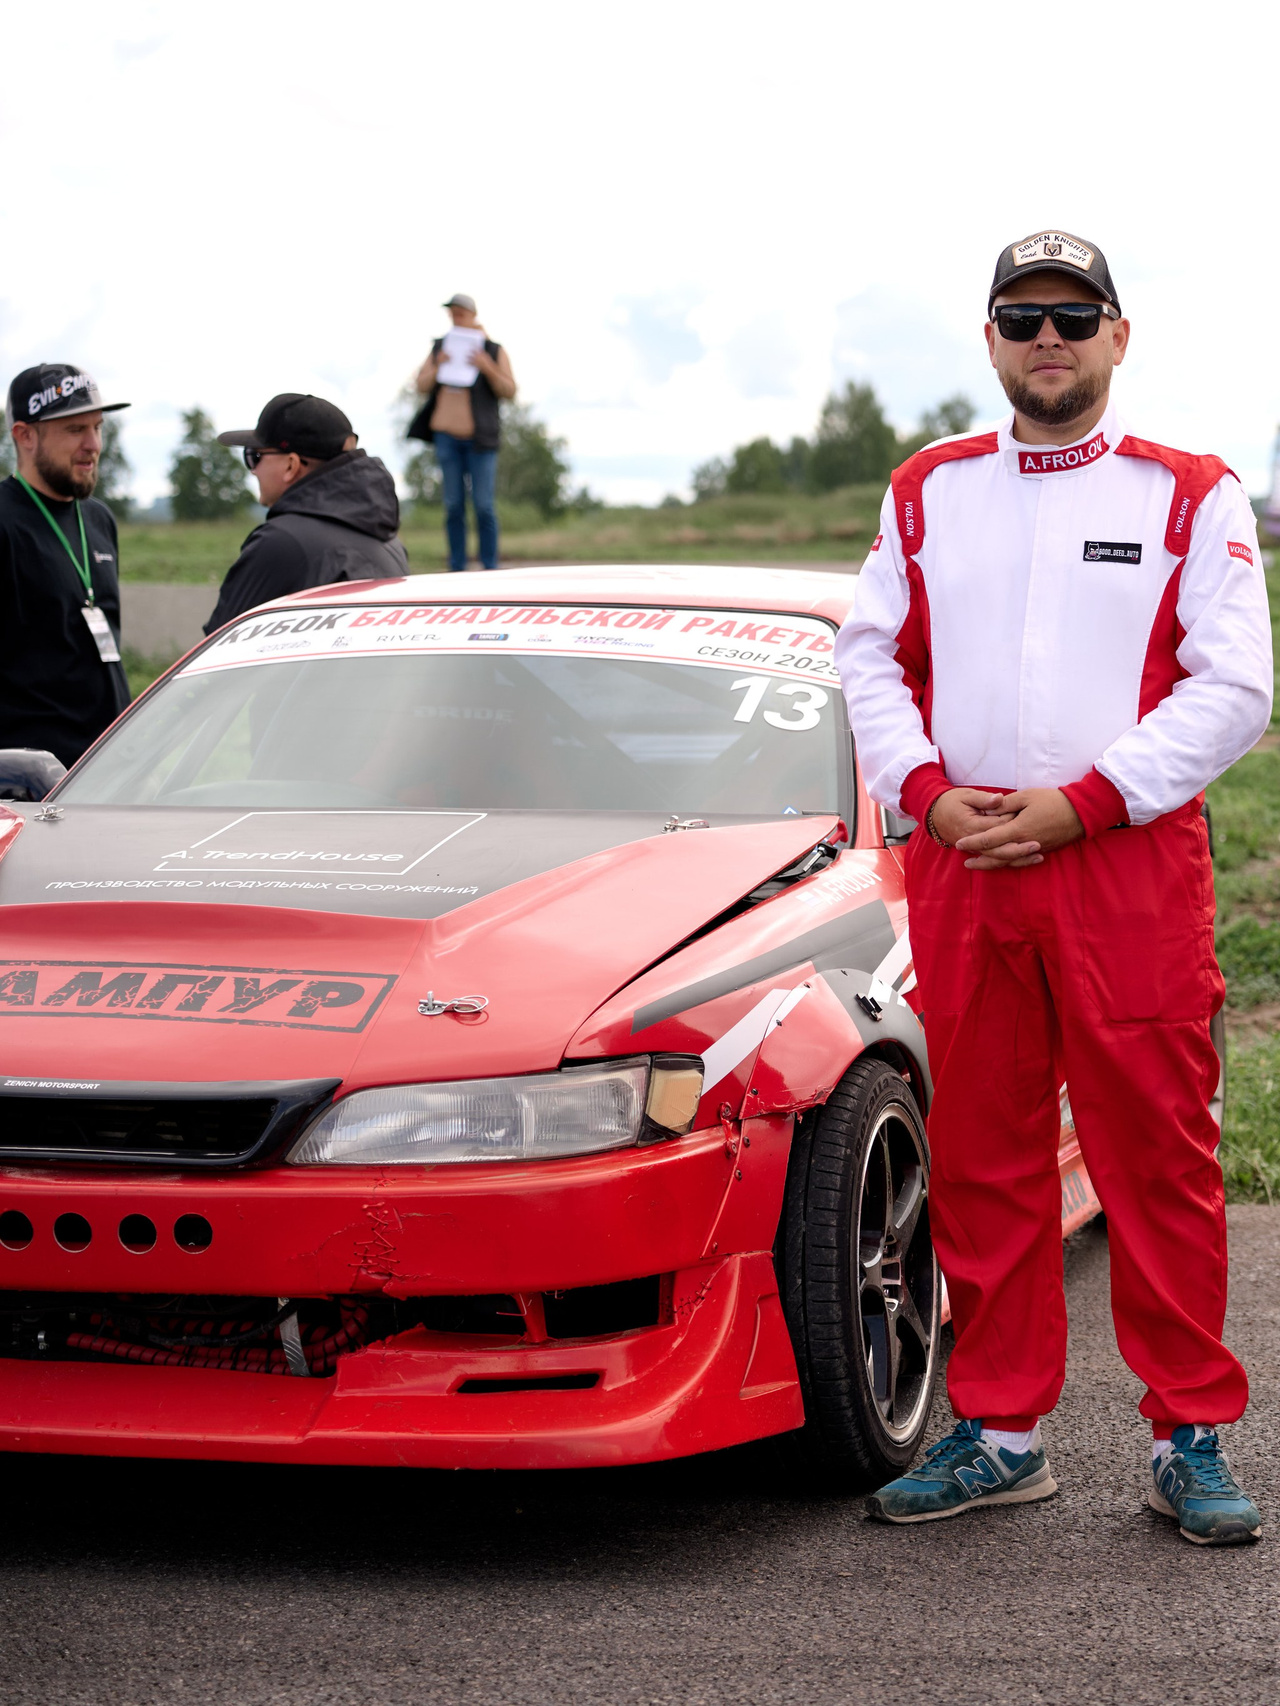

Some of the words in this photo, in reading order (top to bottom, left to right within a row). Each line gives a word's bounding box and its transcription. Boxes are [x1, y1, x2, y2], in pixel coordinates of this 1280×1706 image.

[1018, 234, 1050, 253] GOLDEN
[1054, 234, 1090, 257] KNIGHTS
[1067, 252, 1087, 263] 2017
[28, 385, 60, 416] EVIL
[1024, 437, 1103, 470] A.FROLOV
[904, 501, 915, 537] VOLSON
[1174, 497, 1191, 534] VOLSON
[217, 612, 349, 647] КУБОК
[346, 607, 677, 632] БАРНАУЛЬСКОЙ
[376, 634, 442, 643] RIVER
[696, 645, 771, 664] СЕЗОН
[730, 675, 829, 731] 13
[160, 850, 192, 860] A.
[201, 849, 405, 863] TrendHouse
[44, 879, 204, 891] ПРОИЗВОДСТВО
[206, 879, 332, 892] МОДУЛЬНЫХ
[335, 882, 481, 896] СООРУЖЕНИЙ
[4, 1079, 39, 1088] ZENICH
[38, 1080, 101, 1090] MOTORSPORT
[954, 1456, 1002, 1499] N
